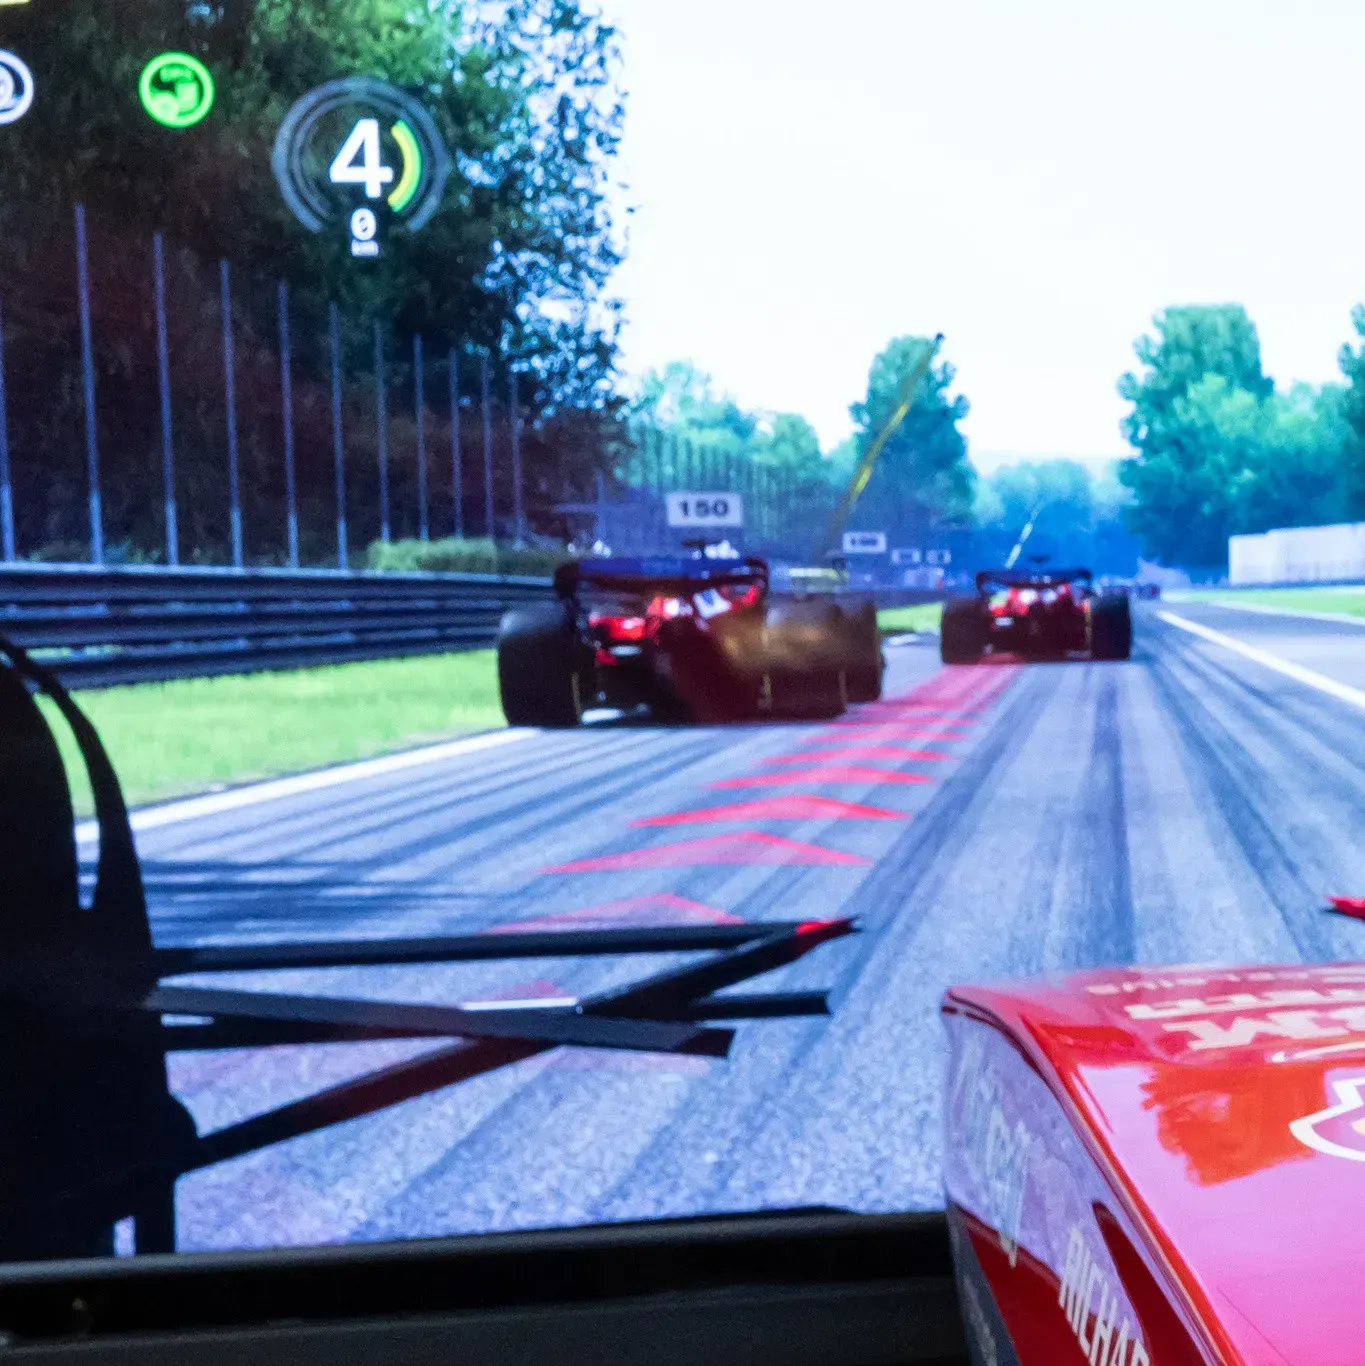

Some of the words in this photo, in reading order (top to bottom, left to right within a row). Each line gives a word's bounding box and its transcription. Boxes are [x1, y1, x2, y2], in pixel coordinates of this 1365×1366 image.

[329, 117, 394, 199] 4
[350, 207, 378, 242] 0
[679, 500, 729, 518] 150
